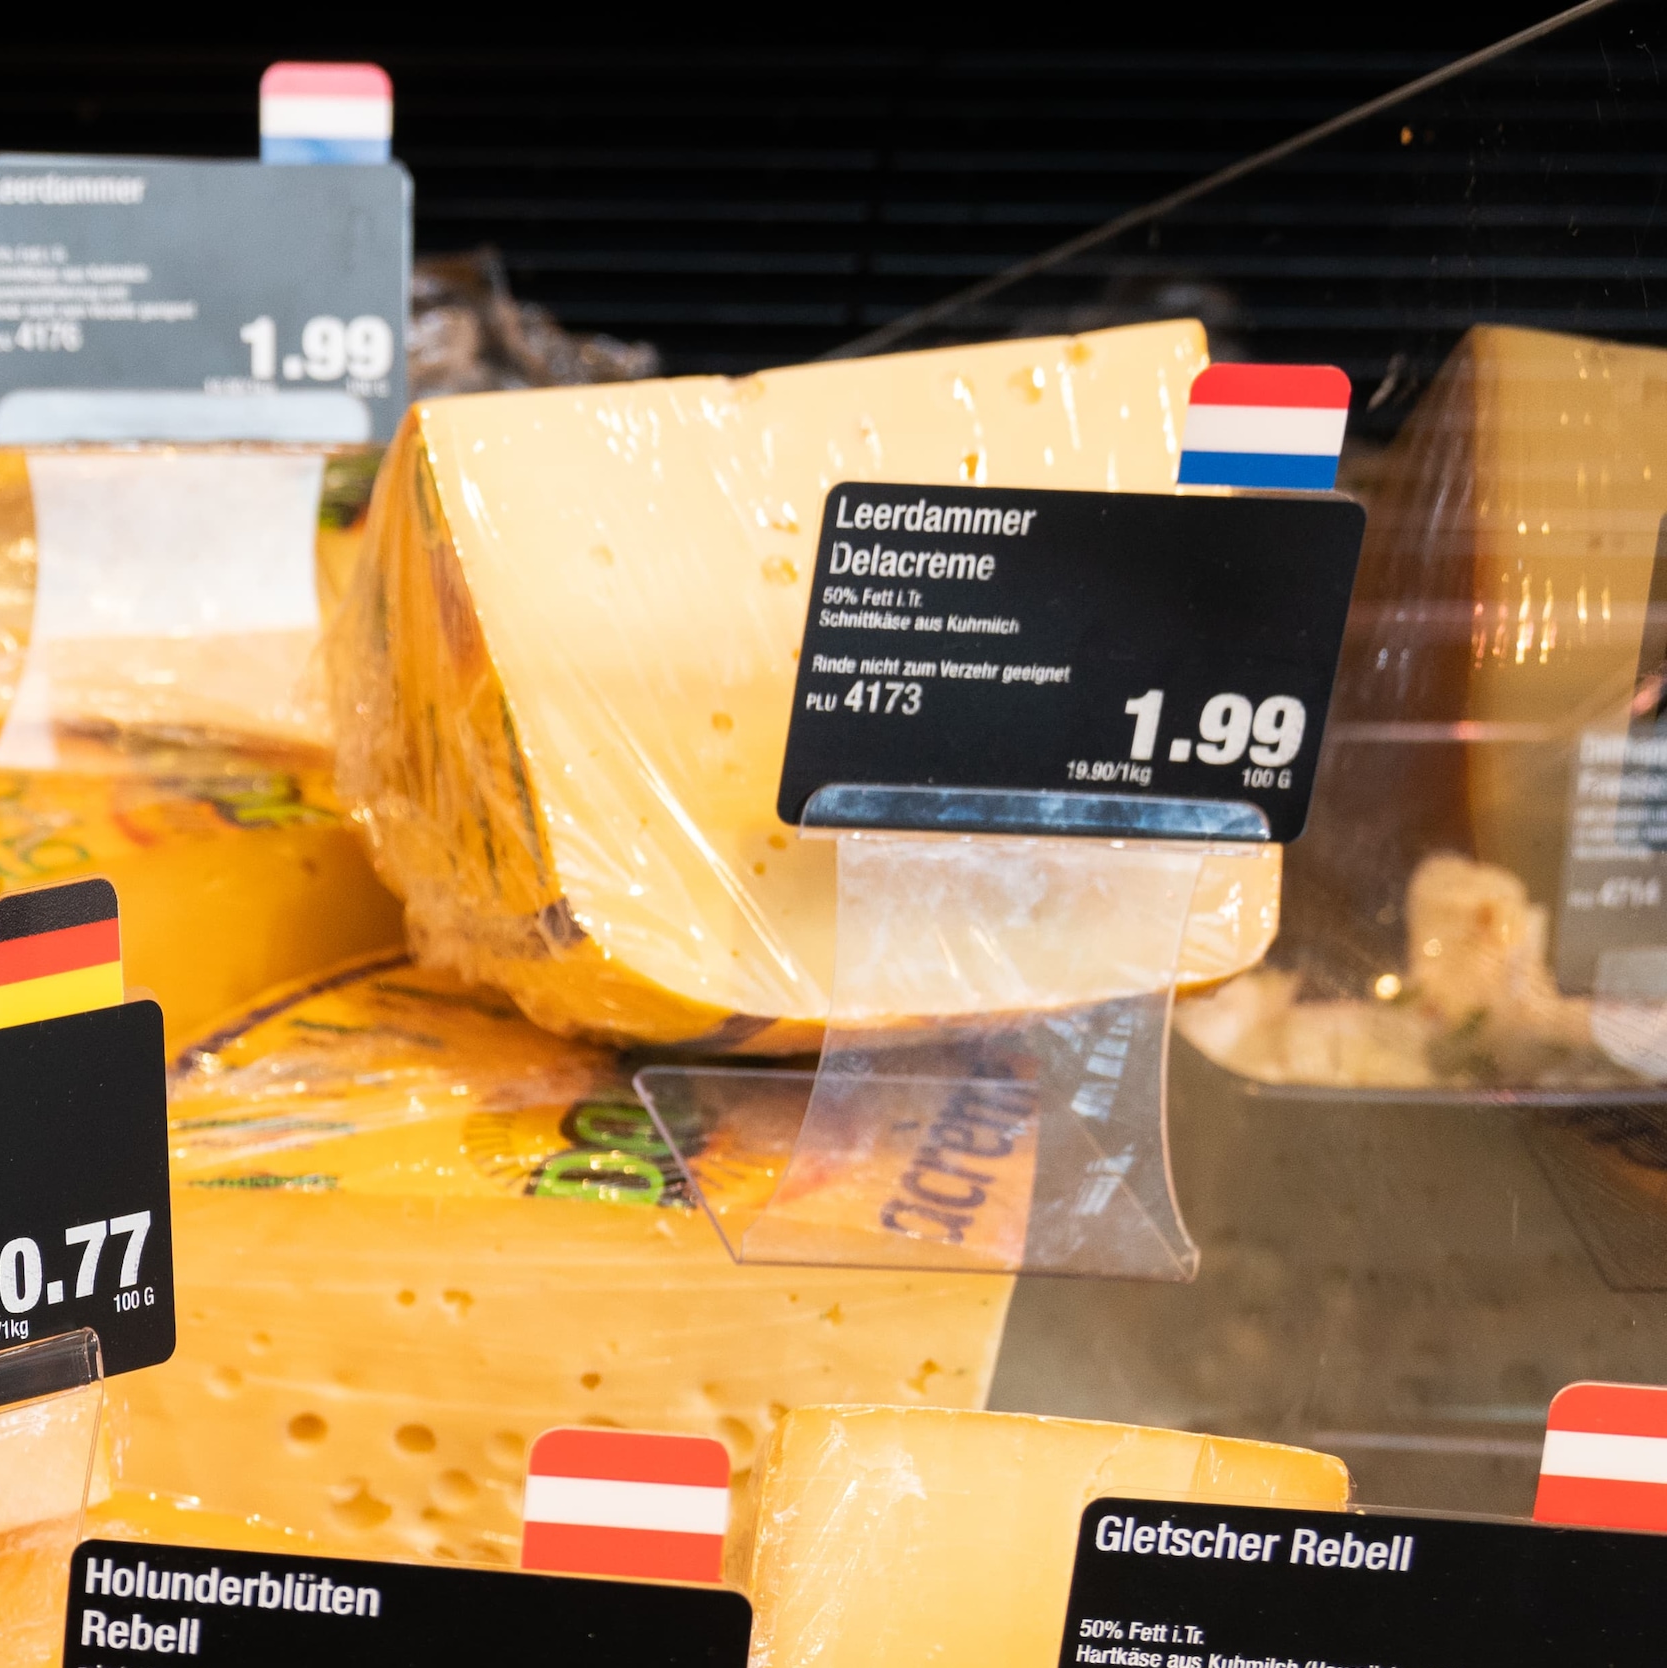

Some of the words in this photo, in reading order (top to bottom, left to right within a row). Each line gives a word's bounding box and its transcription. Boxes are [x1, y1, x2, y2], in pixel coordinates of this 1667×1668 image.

[836, 496, 1036, 535] Leerdammer
[830, 542, 994, 580] Delacreme
[822, 587, 858, 606] 50%
[862, 589, 894, 607] Fett
[819, 609, 911, 630] Schnittkäse
[915, 616, 942, 631] aus
[947, 615, 1019, 634] Kuhmilch
[812, 655, 856, 673] Rinde
[860, 658, 899, 674] nicht
[902, 661, 936, 676] zum
[941, 660, 999, 679] Verzehr
[1002, 665, 1070, 684] geeignet
[844, 680, 922, 714] 4173
[1125, 690, 1305, 767] 1.99
[1067, 761, 1151, 786] 19.90/1kg
[0, 1211, 150, 1313] 0.77
[1096, 1516, 1280, 1561] Gletscher
[1290, 1529, 1413, 1571] Rebell
[85, 1558, 379, 1616] Holunderblüten
[81, 1610, 199, 1654] Rebell
[1076, 1645, 1162, 1668] Hartkäse
